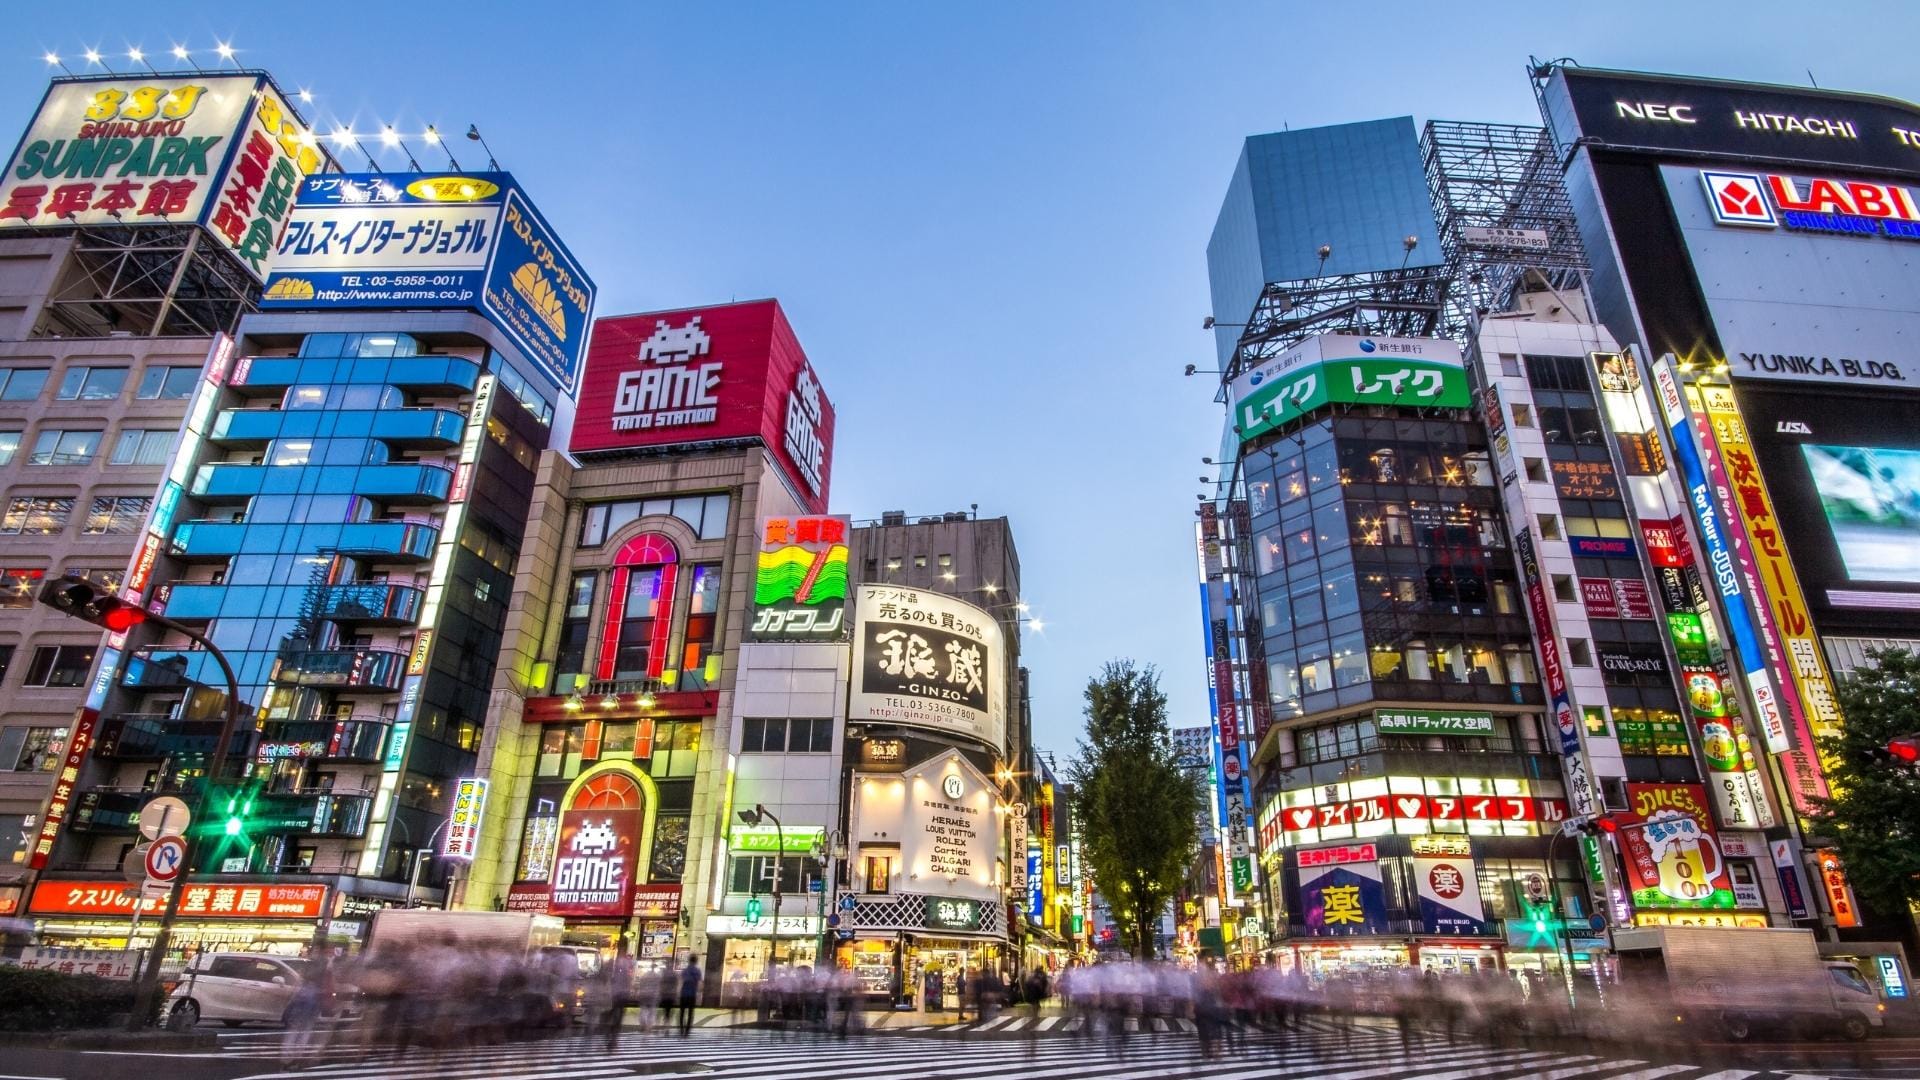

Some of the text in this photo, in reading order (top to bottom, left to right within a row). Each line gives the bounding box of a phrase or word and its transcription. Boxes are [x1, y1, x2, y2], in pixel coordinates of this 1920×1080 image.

[1615, 101, 1696, 123] NEC
[78, 120, 186, 138] SHINJUKU
[1735, 110, 1858, 139] HITACHI
[15, 136, 223, 179] SUNPARK
[0, 179, 198, 220] 三平本館
[1766, 175, 1920, 220] LABI
[1783, 211, 1879, 233] SHINJUKU
[279, 219, 488, 256] アムス・インターナショナル
[506, 203, 588, 314] アムス・インターナショナル
[316, 289, 474, 302] http://www.amms.co.jp
[486, 288, 573, 386] http://www.amms.co.jp
[1379, 342, 1423, 354] 新生銀行
[1266, 353, 1302, 378] 新生銀行
[1742, 353, 1906, 380] YUNIKA BLDG.
[613, 362, 723, 414] GAME
[1351, 366, 1444, 397] レイク
[1244, 373, 1317, 430] レイク
[1664, 382, 1679, 408] LABI
[1708, 401, 1735, 409] LABI
[612, 407, 717, 431] TAITO STATION
[1776, 422, 1812, 434] LISA
[786, 390, 825, 484] GAME
[785, 433, 821, 499] TAITO STATION
[1553, 462, 1613, 475] 本格台湾式
[1561, 486, 1615, 498] マッサージ
[1569, 475, 1602, 486] オイル
[1645, 529, 1670, 538] FAST
[1647, 538, 1674, 548] NAIL
[1579, 541, 1627, 552] PROMISE
[1711, 548, 1741, 596] JUST
[866, 589, 918, 604] ブランド品
[1583, 584, 1608, 592] FAST
[1587, 592, 1611, 601] NAIL
[752, 607, 844, 632] カワノ
[875, 629, 984, 696] 銀蔵
[1542, 639, 1564, 692] アイフル
[869, 707, 943, 723] http://ginzo.jp
[885, 697, 976, 721] TEL.03-5366-7800
[1559, 713, 1574, 728] 薬
[1764, 703, 1783, 736] LABI
[1222, 706, 1237, 747] アイフル
[1379, 713, 1492, 731] 高興リラックス空間
[1225, 762, 1240, 774] 薬
[1571, 757, 1593, 812] 大勝軒
[447, 783, 474, 853] まんが喫茶
[1228, 797, 1247, 841] 大勝軒
[1319, 798, 1384, 826] アイフル
[1434, 797, 1563, 822] アイフル
[1636, 788, 1709, 830] カルビちゃん
[925, 825, 977, 838] LOUIS VUITTON
[936, 836, 967, 847] ROLEX
[930, 855, 971, 867] BVLGARI
[934, 845, 968, 857] Cartier
[1300, 846, 1376, 865] ミネドラッグ
[555, 857, 624, 890] GAME
[930, 865, 970, 876] CHANEL
[1236, 860, 1248, 886] レイク
[1433, 867, 1462, 894] 薬
[268, 889, 320, 900] 処方せん受付
[553, 891, 619, 903] TAITO STATION
[1321, 884, 1365, 926] 薬
[1828, 872, 1849, 914] 吉野家
[1561, 929, 1599, 938] ANDOR
[22, 959, 131, 977] ポイ捨て禁止
[1883, 959, 1893, 975] P
